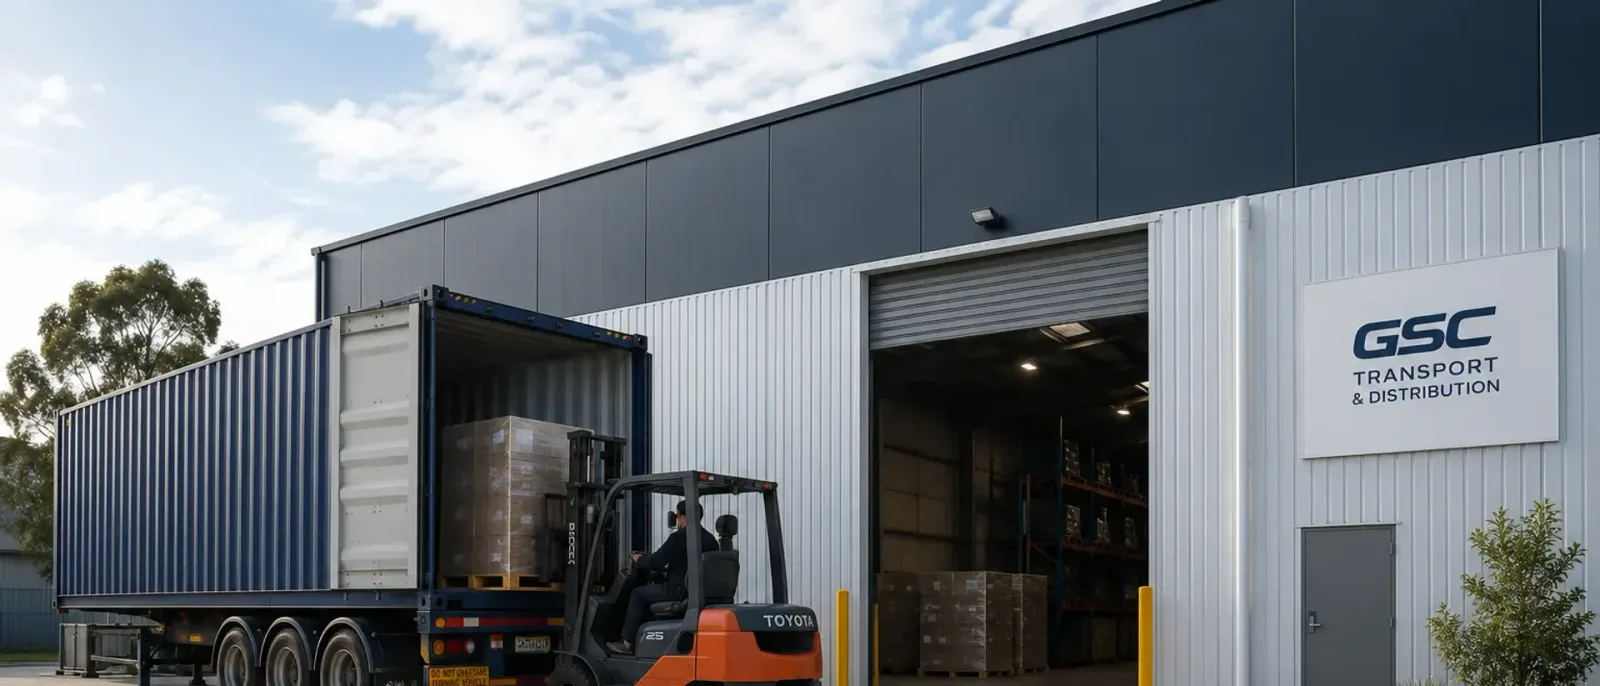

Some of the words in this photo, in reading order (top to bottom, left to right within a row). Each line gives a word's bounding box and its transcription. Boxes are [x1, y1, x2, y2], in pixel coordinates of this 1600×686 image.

[1353, 306, 1496, 359] GSC
[1353, 357, 1498, 385] TRANSPORT
[1352, 392, 1363, 405] &
[1369, 379, 1500, 404] DISTRIBUTION
[763, 615, 815, 627] TOYOTA
[645, 632, 664, 640] 25
[431, 669, 441, 678] DO
